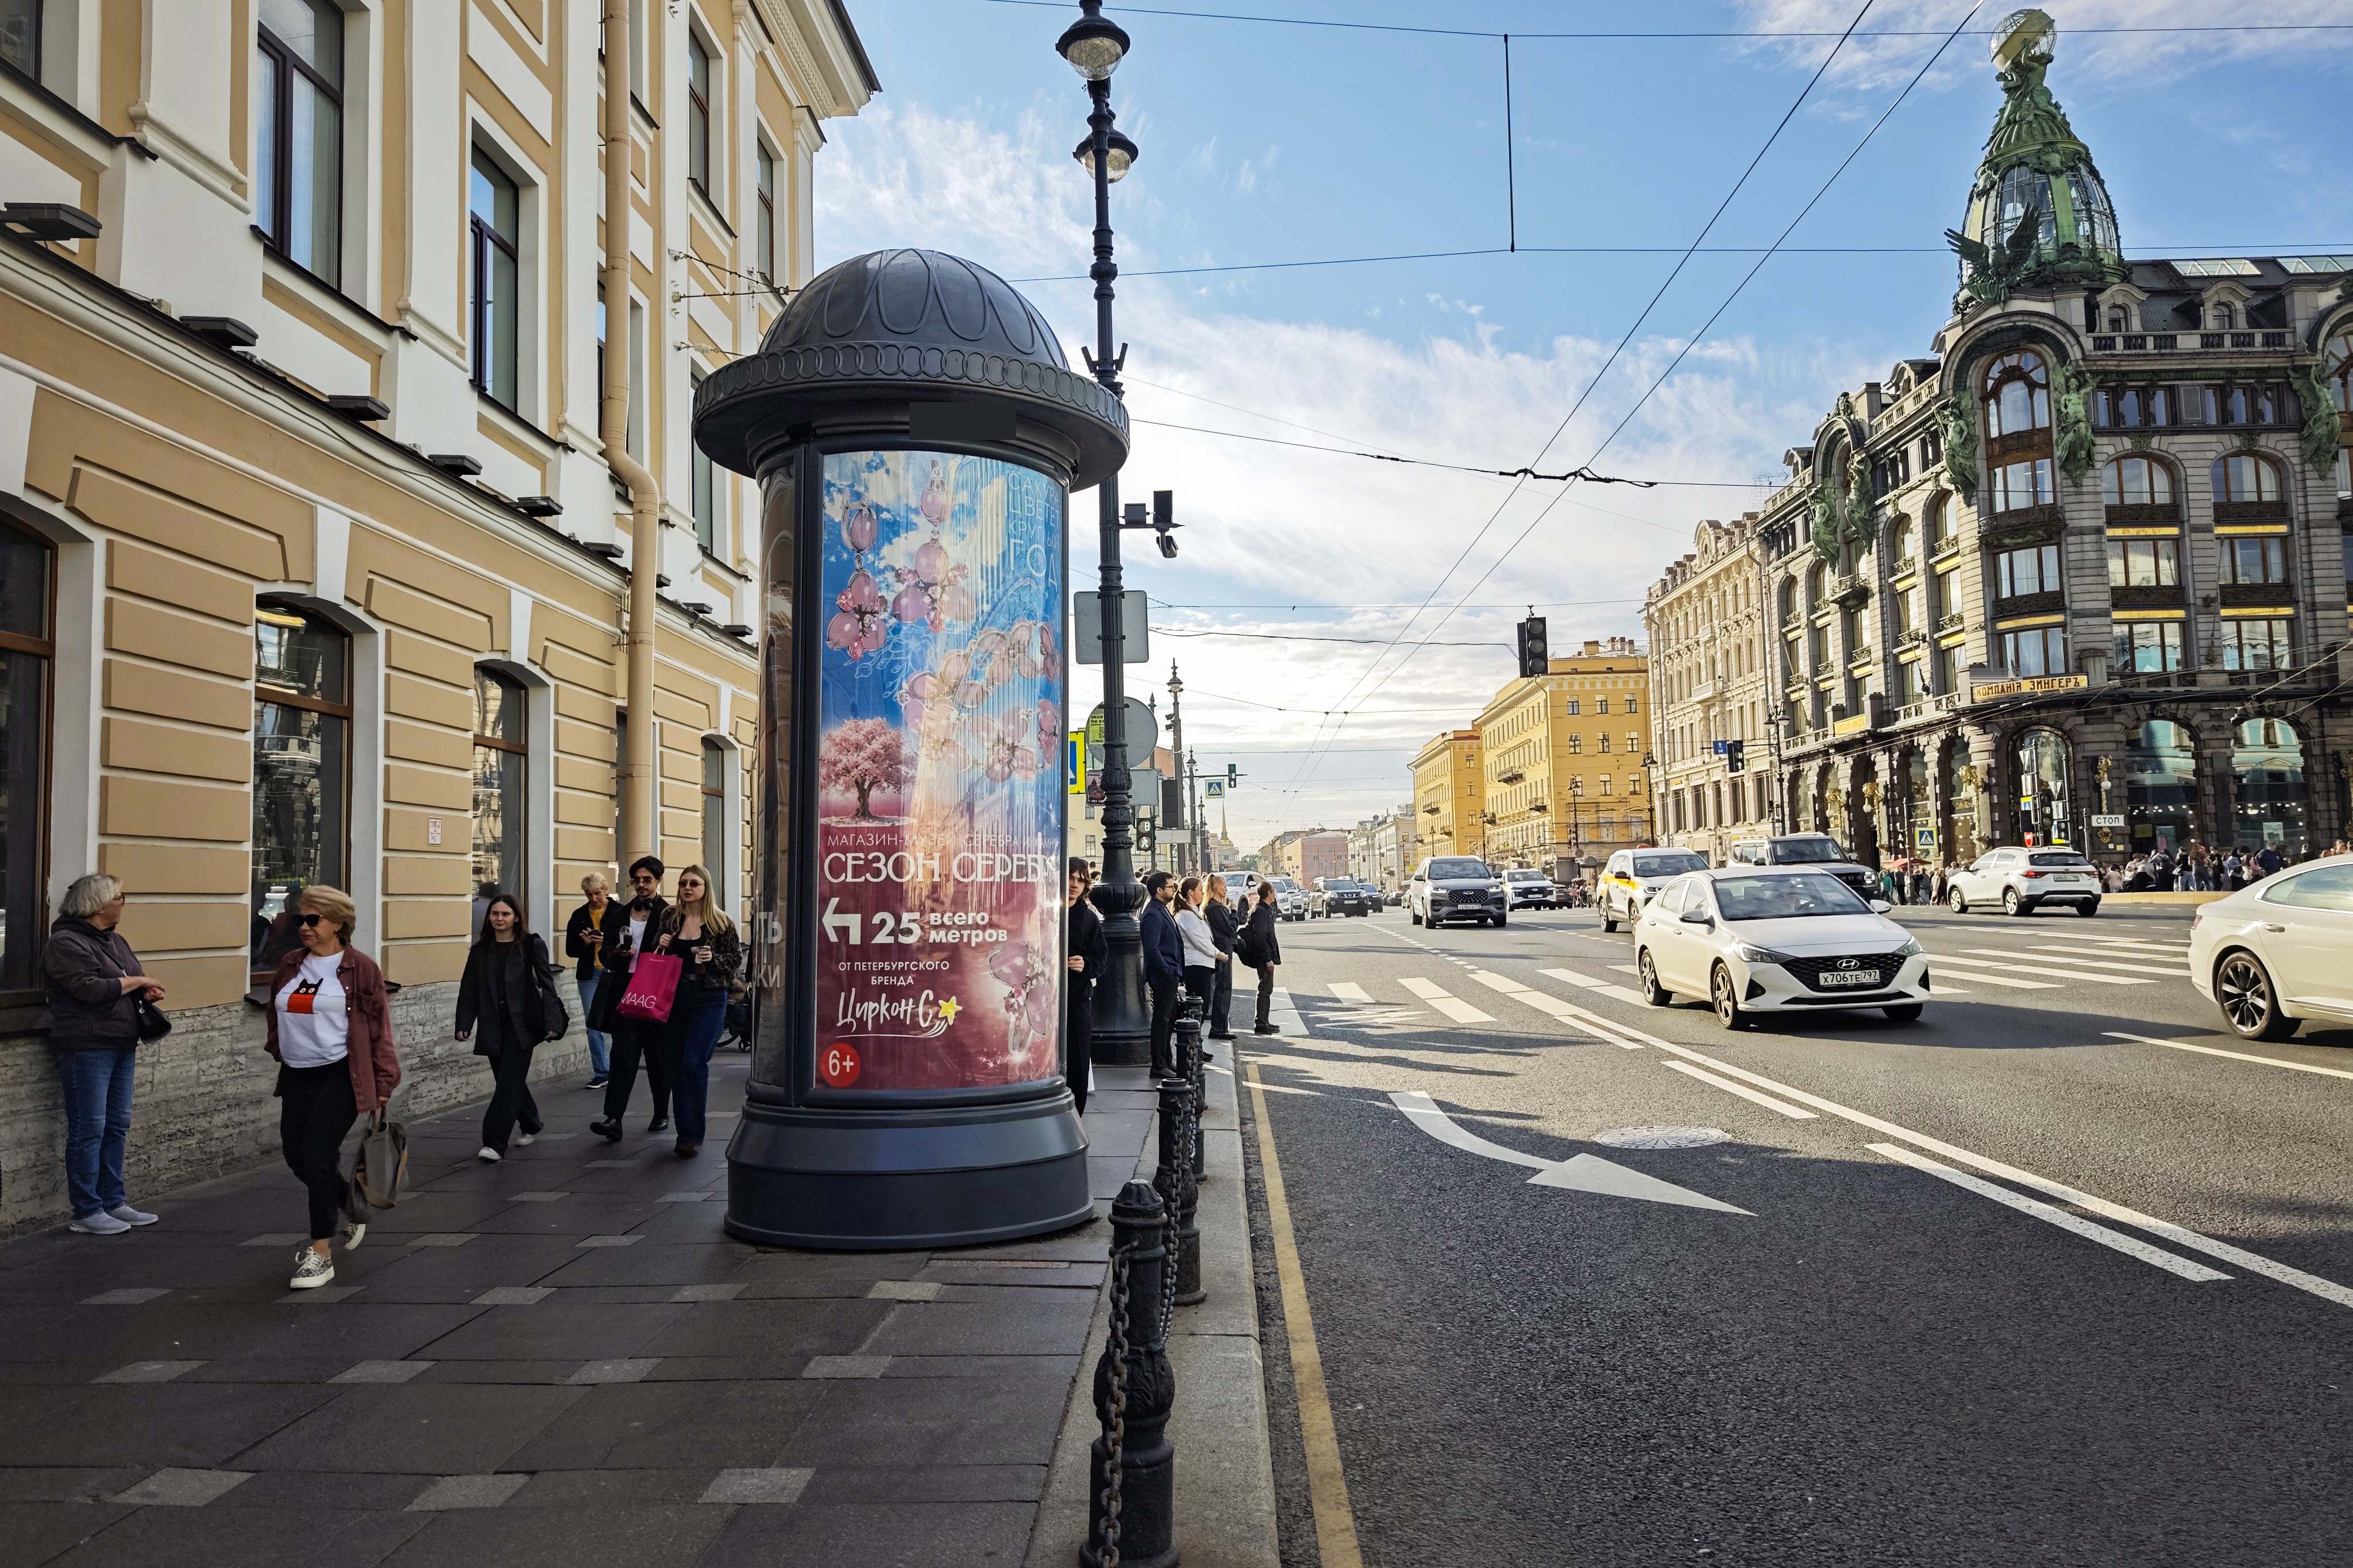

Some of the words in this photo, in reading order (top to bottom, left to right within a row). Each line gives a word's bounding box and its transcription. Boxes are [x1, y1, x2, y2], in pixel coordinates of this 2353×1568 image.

[1009, 492, 1059, 529] ЦВЕТЕТ
[1008, 520, 1059, 551] КРУГЛЫЙ
[1010, 538, 1058, 592] ГОД
[2030, 677, 2080, 690] ЗИНГЕРЪ
[827, 831, 956, 847] МАГАЗИН-МУЗЕЙ
[963, 833, 1019, 847] СЕРЕБРА
[824, 851, 941, 883] СЕЗОН
[929, 912, 989, 926] всего
[870, 912, 921, 944] 25
[928, 929, 1008, 947] метров
[839, 961, 851, 971] ОТ
[854, 960, 950, 971] ПЕТЕРБУРГСКОГО
[871, 975, 915, 987] БРЕНДА
[1862, 971, 1877, 979] 797
[622, 992, 657, 1008] MAAG
[828, 1050, 854, 1076] 6+
